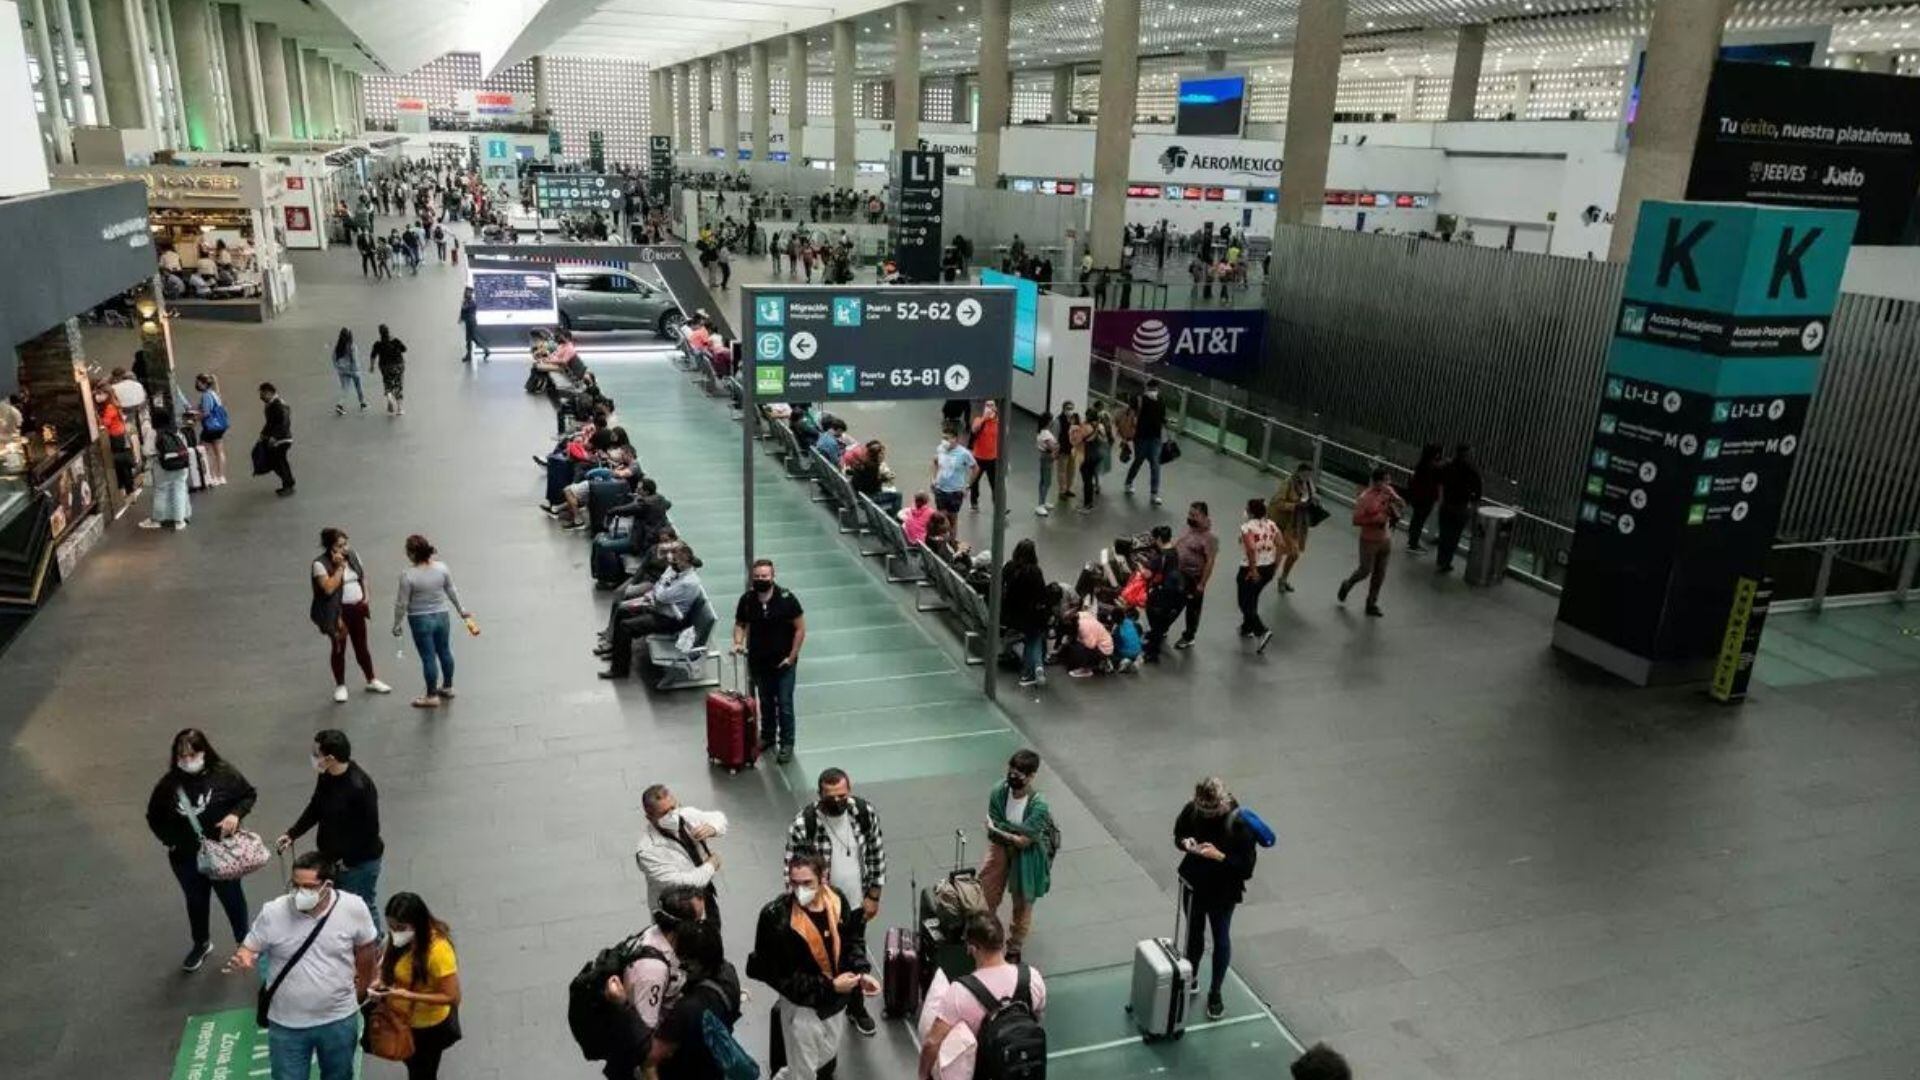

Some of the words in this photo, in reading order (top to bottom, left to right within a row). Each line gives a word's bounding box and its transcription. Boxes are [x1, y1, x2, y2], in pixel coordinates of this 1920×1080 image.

[1719, 117, 1738, 134] Tu
[1741, 117, 1778, 139] éxito,
[1782, 123, 1834, 140] nuestra
[1836, 126, 1913, 145] plataforma.
[652, 137, 668, 150] L2
[911, 156, 936, 182] L1
[1190, 153, 1284, 172] AEROMEXICO
[161, 174, 240, 190] KAYSER
[1762, 163, 1807, 182] JEEVES
[655, 250, 682, 260] BUICK
[1655, 217, 1716, 292] K
[1767, 225, 1824, 300] K
[896, 302, 951, 320] 52-62
[1174, 327, 1245, 354] AT&T
[890, 368, 940, 386] 63-81
[1624, 385, 1659, 405] L1-L3
[1731, 402, 1764, 419] L1-L3
[1664, 432, 1678, 449] M
[1765, 438, 1780, 453] M
[649, 984, 660, 1007] 3
[216, 1031, 240, 1065] Zona
